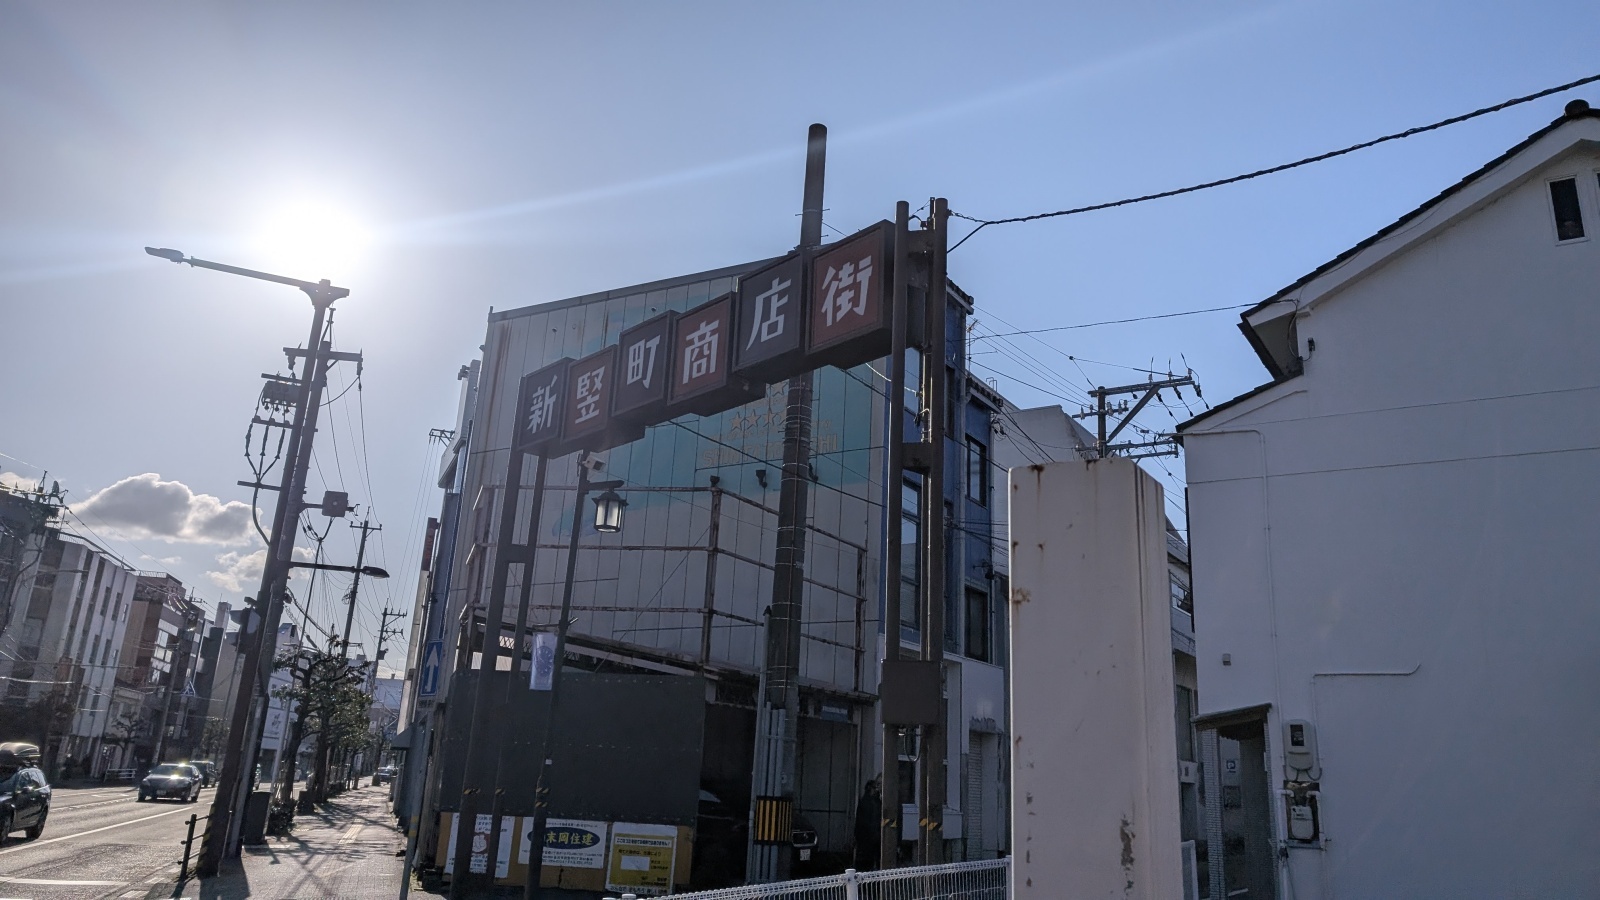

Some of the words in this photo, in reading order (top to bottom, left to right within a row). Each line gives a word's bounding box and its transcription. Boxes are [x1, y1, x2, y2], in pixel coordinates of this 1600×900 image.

[526, 255, 873, 434] 新竪町商店街
